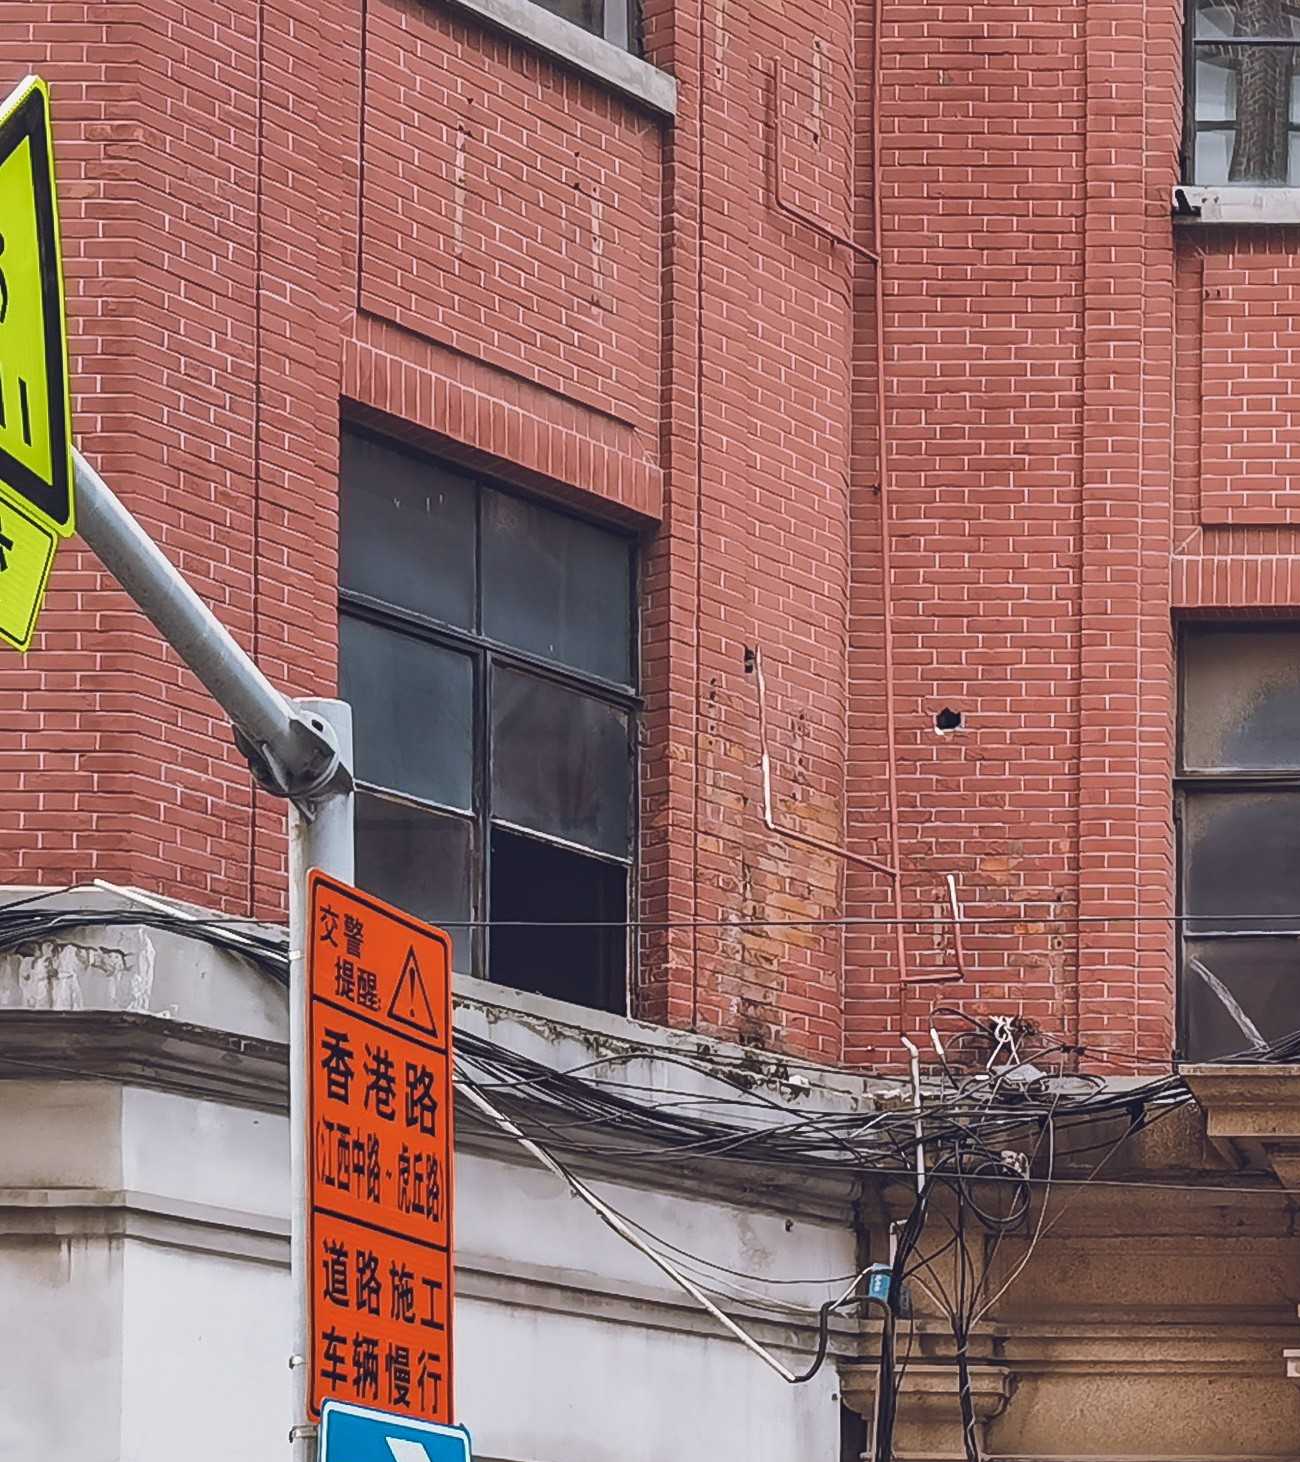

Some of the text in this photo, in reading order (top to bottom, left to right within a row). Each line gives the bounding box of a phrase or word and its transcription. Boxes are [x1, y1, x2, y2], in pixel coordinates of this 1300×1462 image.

[319, 904, 364, 959] 交警
[320, 1026, 438, 1137] 香港路
[322, 1237, 445, 1332] 道路施工
[320, 1324, 443, 1414] 车辆慢行
